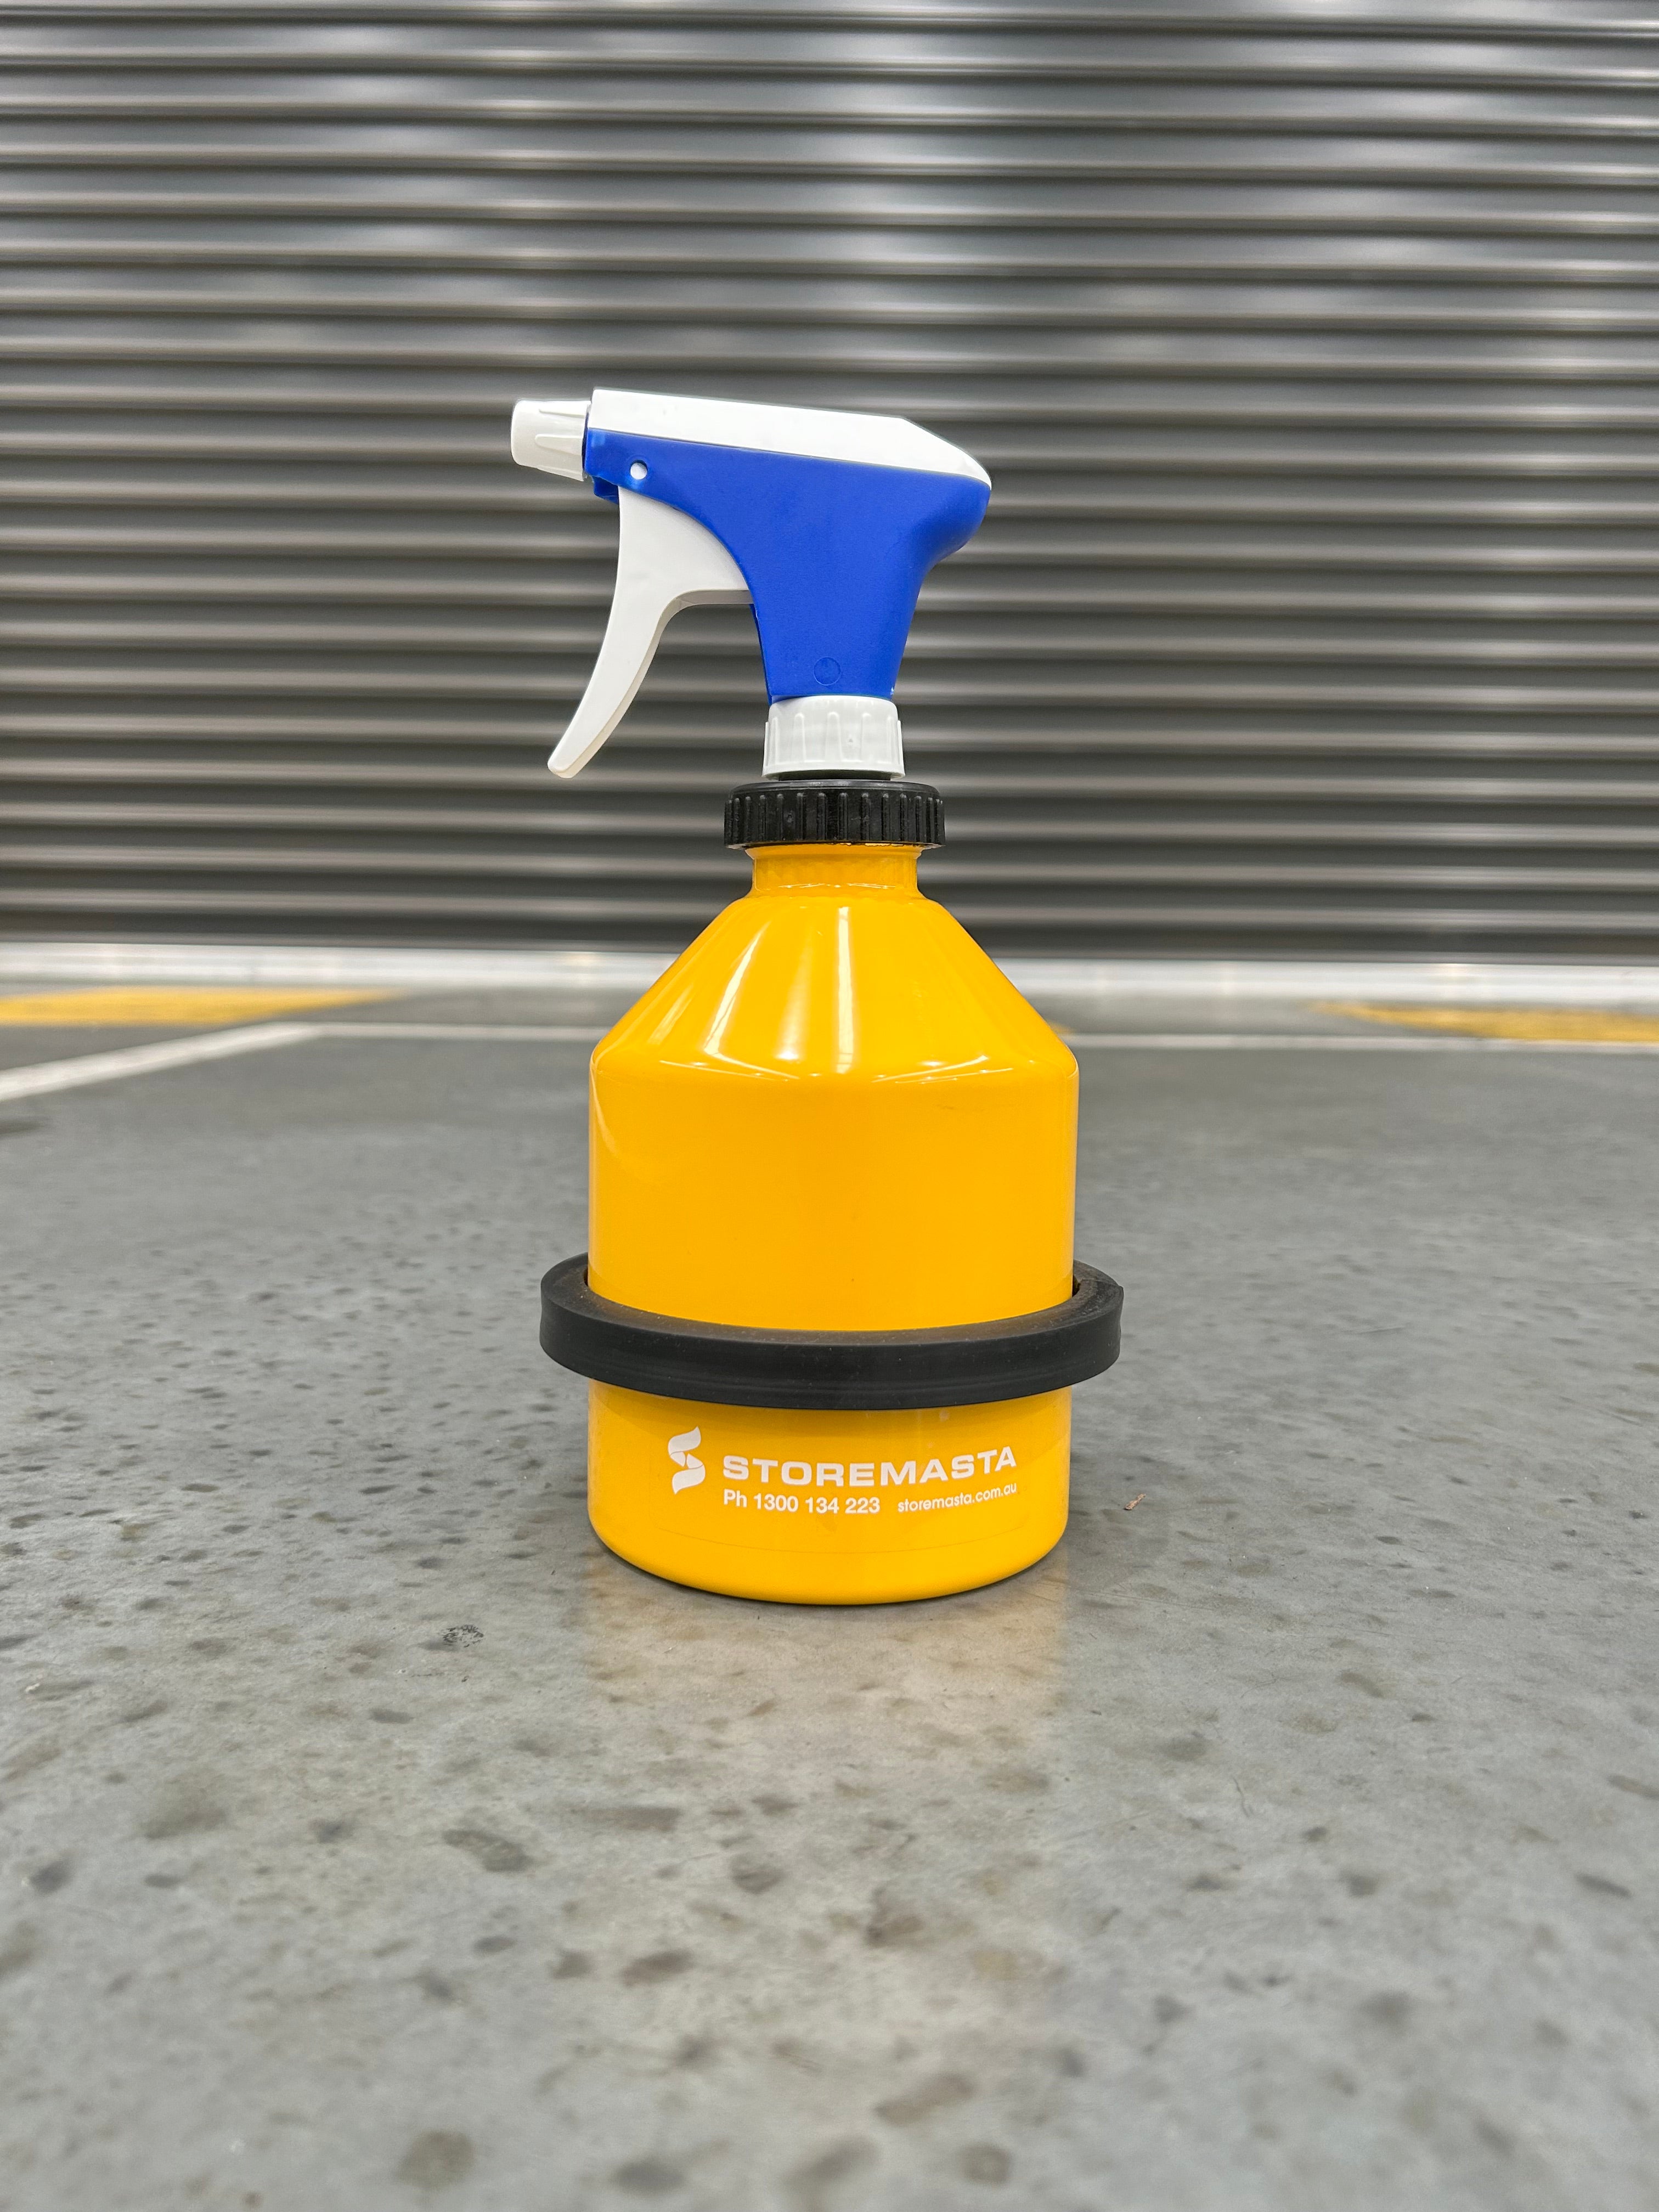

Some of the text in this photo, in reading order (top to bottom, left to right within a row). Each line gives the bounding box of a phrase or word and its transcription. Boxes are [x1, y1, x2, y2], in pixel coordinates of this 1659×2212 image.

[723, 1446, 1017, 1487] STOREMASTA
[724, 1483, 1017, 1514] Ph 1300 134 223 storemasta.com.au
